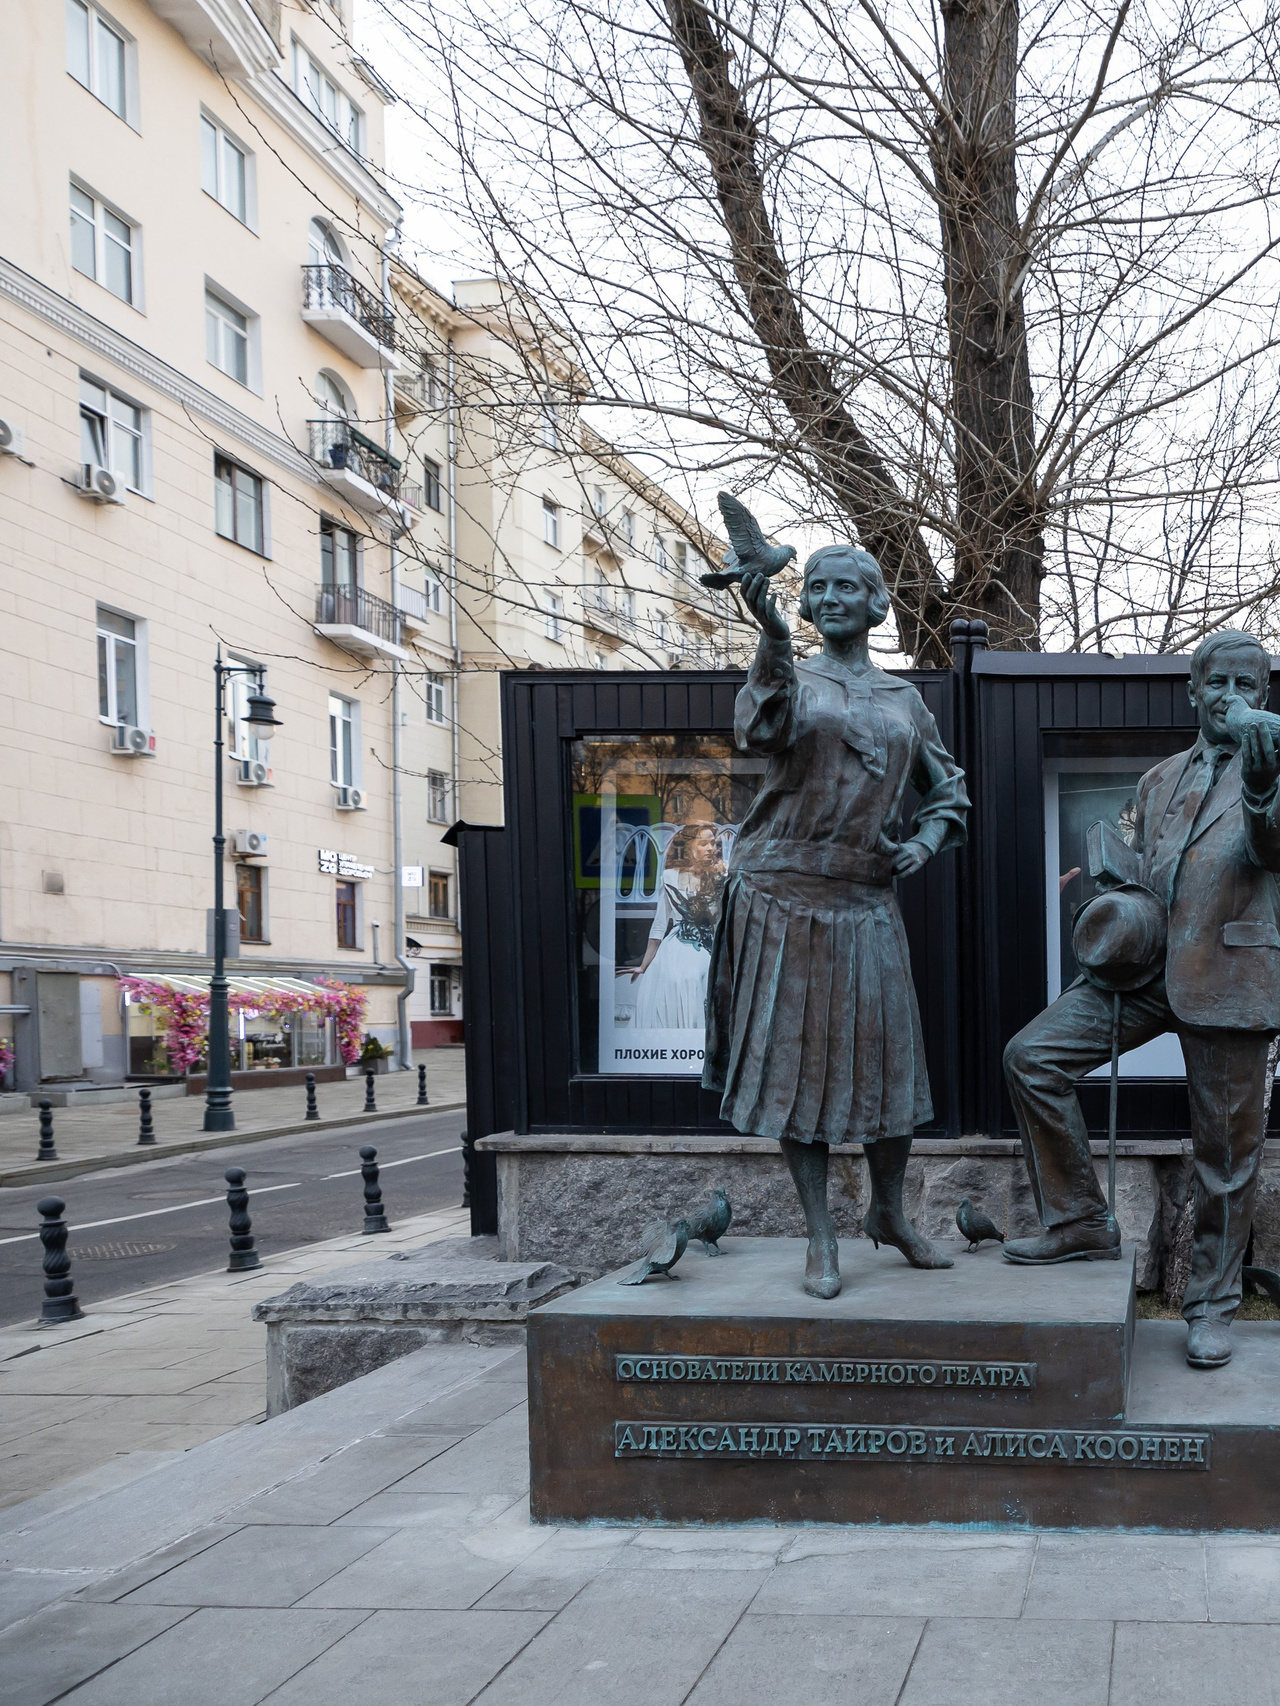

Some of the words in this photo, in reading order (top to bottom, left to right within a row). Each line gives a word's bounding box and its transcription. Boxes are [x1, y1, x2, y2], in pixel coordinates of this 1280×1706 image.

[614, 1048, 668, 1060] ПЛОХИЕ
[617, 1359, 780, 1382] ОСНОВАТЕЛИ
[784, 1362, 938, 1386] КАМЕРНОГО
[941, 1365, 1031, 1387] ТЕАТРА
[617, 1426, 801, 1456] АЛЕКСАНДР
[806, 1428, 928, 1455] ТАИРОВ
[935, 1436, 955, 1456] и
[961, 1432, 1069, 1459] АЛИСА
[1074, 1434, 1205, 1463] КООНЕН
